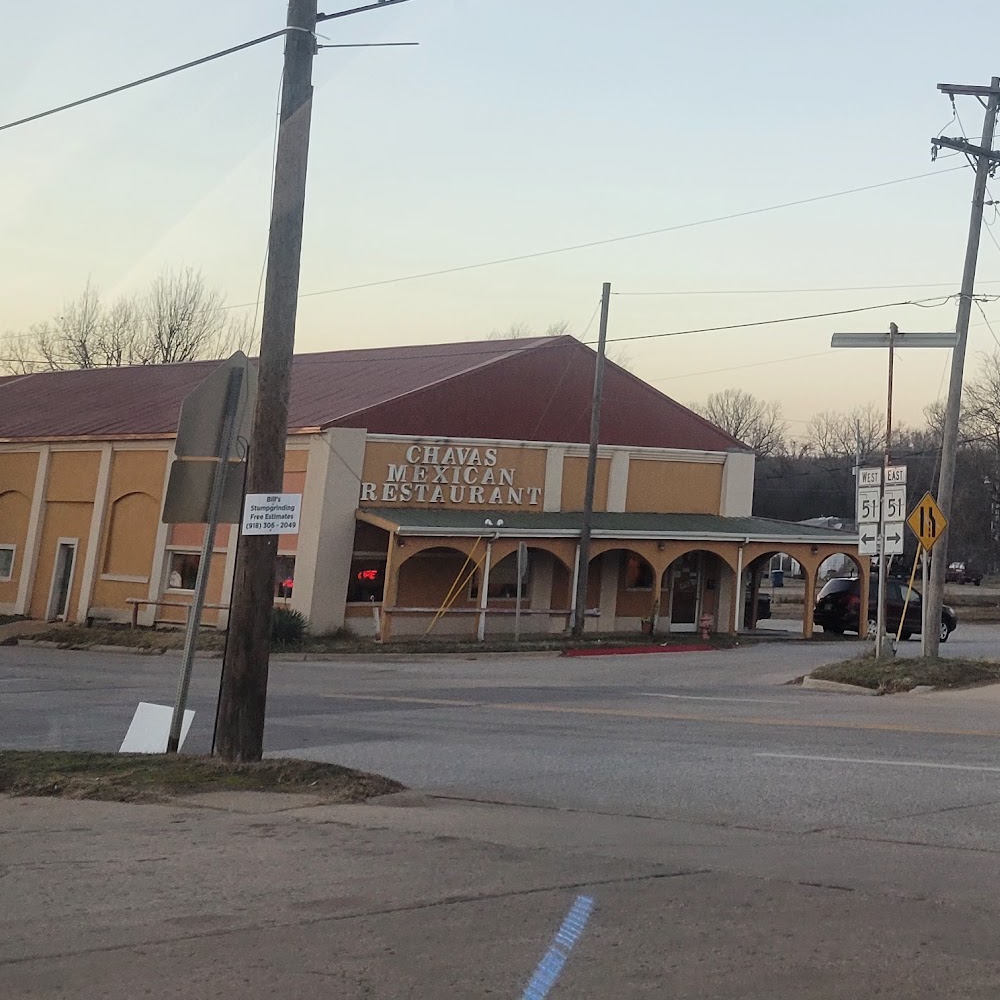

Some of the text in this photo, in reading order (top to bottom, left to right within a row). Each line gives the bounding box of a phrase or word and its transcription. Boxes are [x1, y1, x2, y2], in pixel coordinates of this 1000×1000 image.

[406, 445, 498, 466] CHAVAS
[386, 464, 516, 486] MEXICAN
[862, 472, 878, 483] WEST
[887, 470, 903, 481] EAST
[360, 482, 542, 505] RESTAURANT
[862, 500, 876, 519] 51
[888, 498, 902, 517] 51
